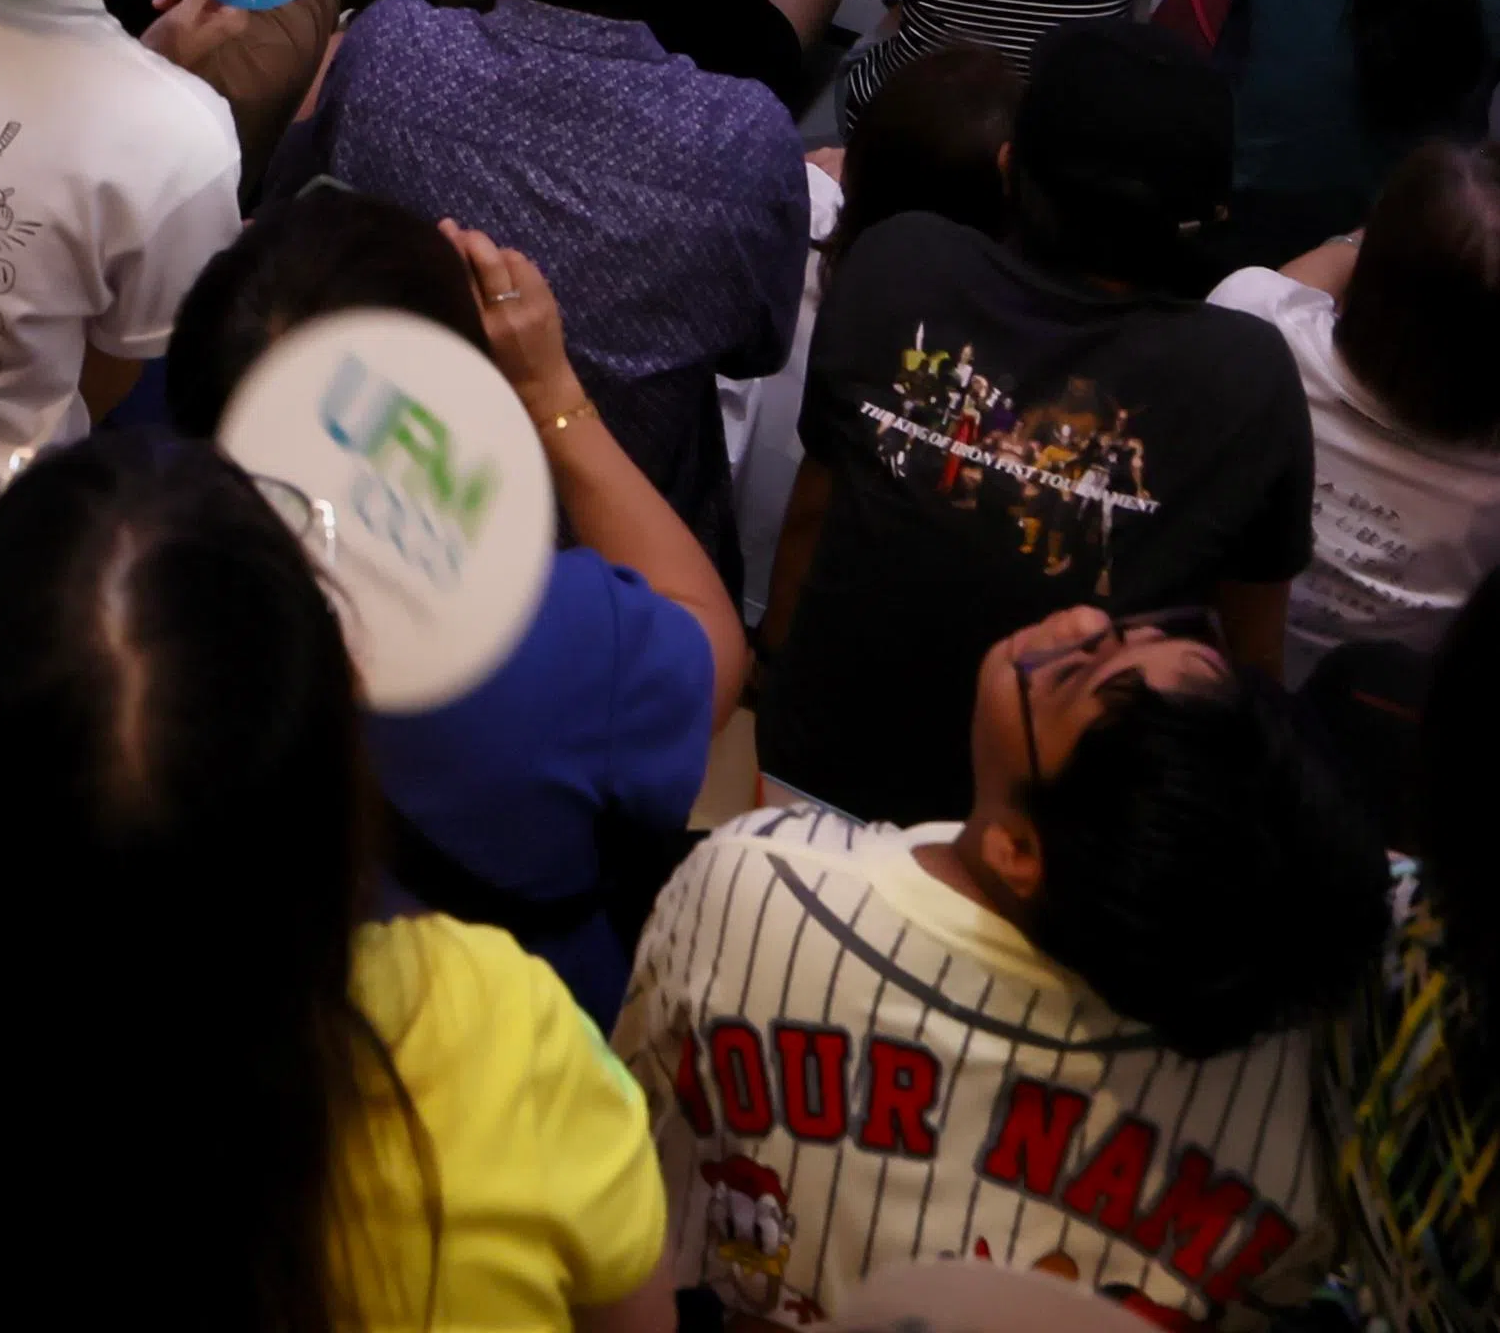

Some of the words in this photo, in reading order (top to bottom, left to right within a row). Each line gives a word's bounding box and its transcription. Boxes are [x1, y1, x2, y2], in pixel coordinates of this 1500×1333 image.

[860, 400, 896, 428] THE
[893, 416, 929, 440] KING
[928, 432, 951, 450] OF
[950, 440, 994, 467] IRON
[995, 456, 1034, 480] FIST
[976, 1076, 1300, 1306] NAME
